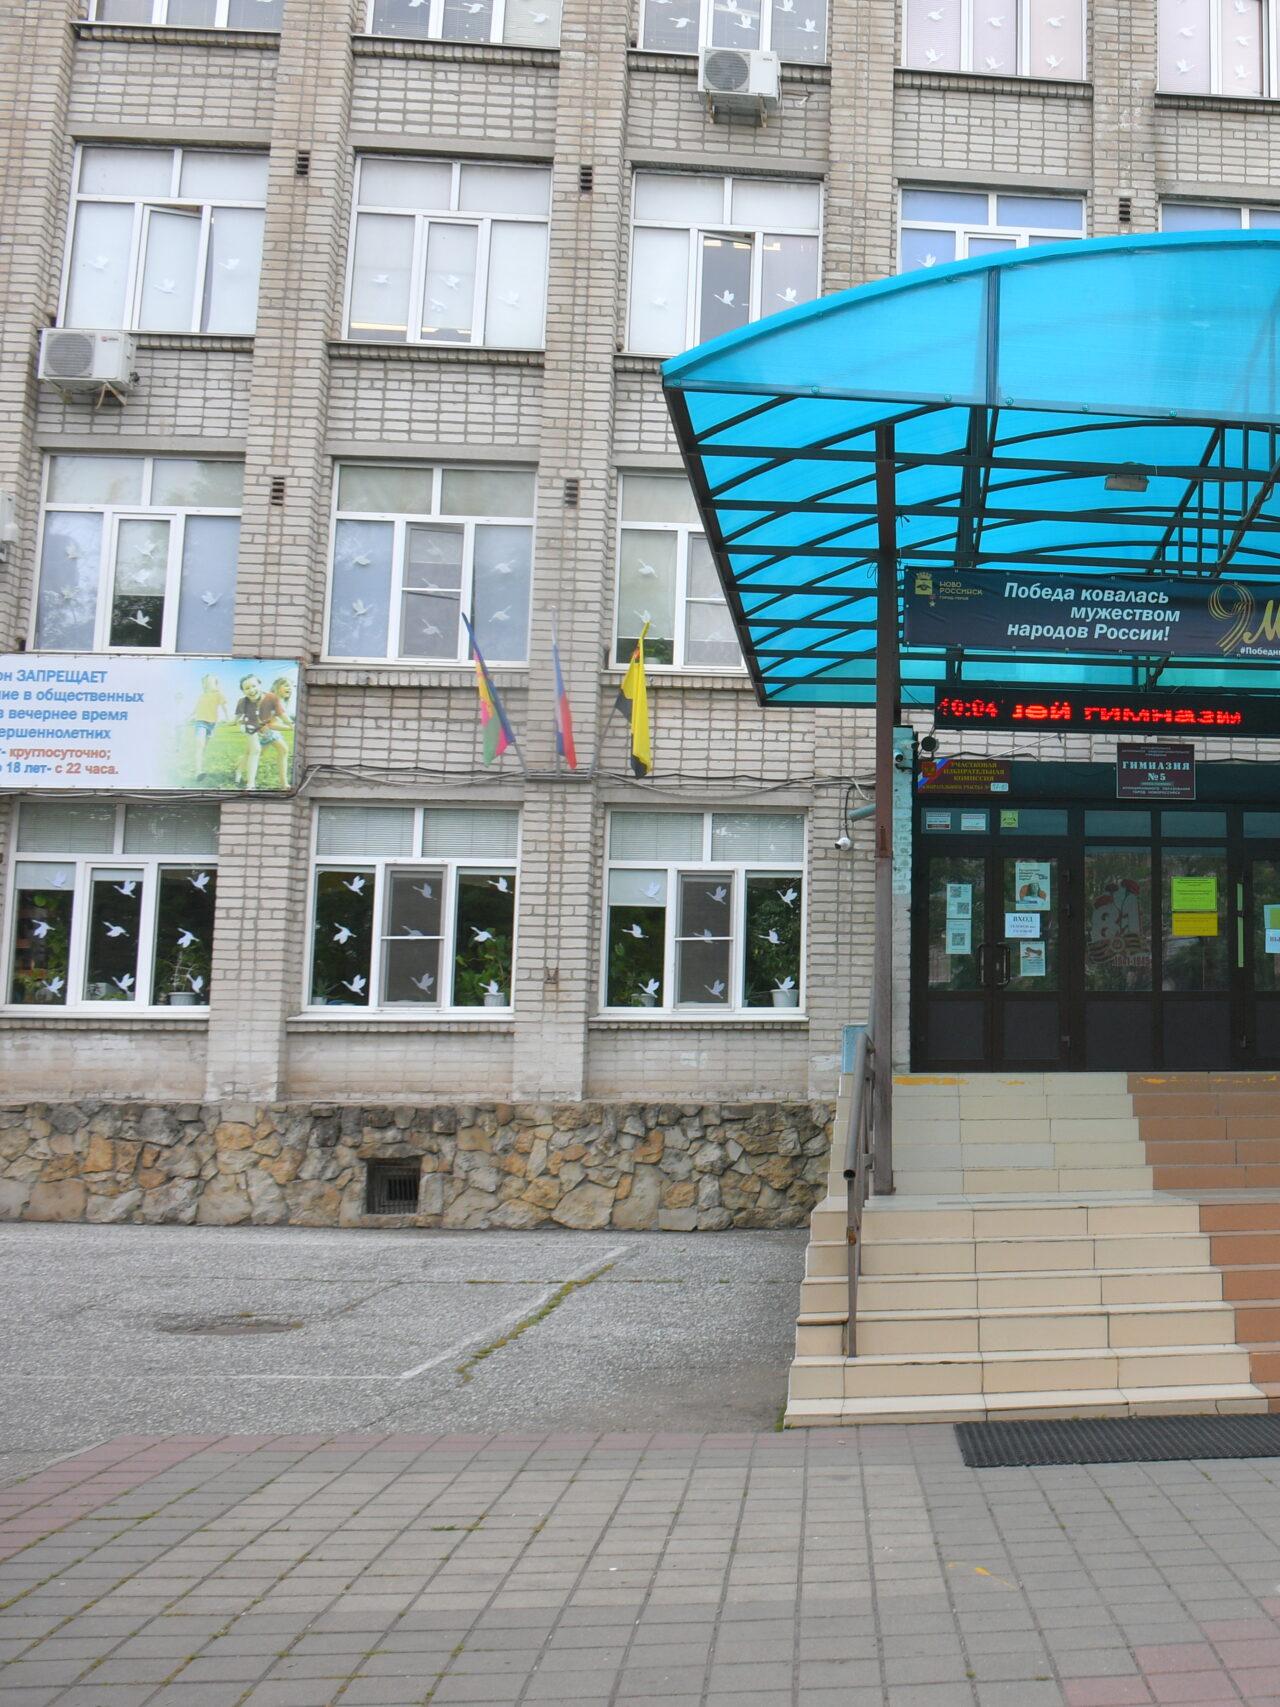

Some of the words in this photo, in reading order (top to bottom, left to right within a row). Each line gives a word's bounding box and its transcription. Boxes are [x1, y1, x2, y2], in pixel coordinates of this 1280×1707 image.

[1004, 582, 1074, 602] Победа
[1081, 587, 1169, 604] ковалась
[1070, 605, 1181, 623] мужеством
[1208, 582, 1255, 656] 9
[1007, 624, 1088, 640] народов
[1094, 624, 1169, 641] России!
[16, 669, 108, 685] ЗАПРЕЩАЕТ
[24, 690, 32, 700] в
[37, 688, 145, 704] общественных
[9, 709, 78, 722] вечернее
[82, 710, 128, 722] время
[9, 748, 111, 761] круглосуточно;
[7, 762, 21, 773] 18
[55, 765, 63, 774] с
[66, 763, 82, 774] 22
[85, 764, 119, 776] часа.
[1122, 760, 1190, 771] ГИМНАЗИЯ
[1012, 915, 1033, 923] ВХОД
